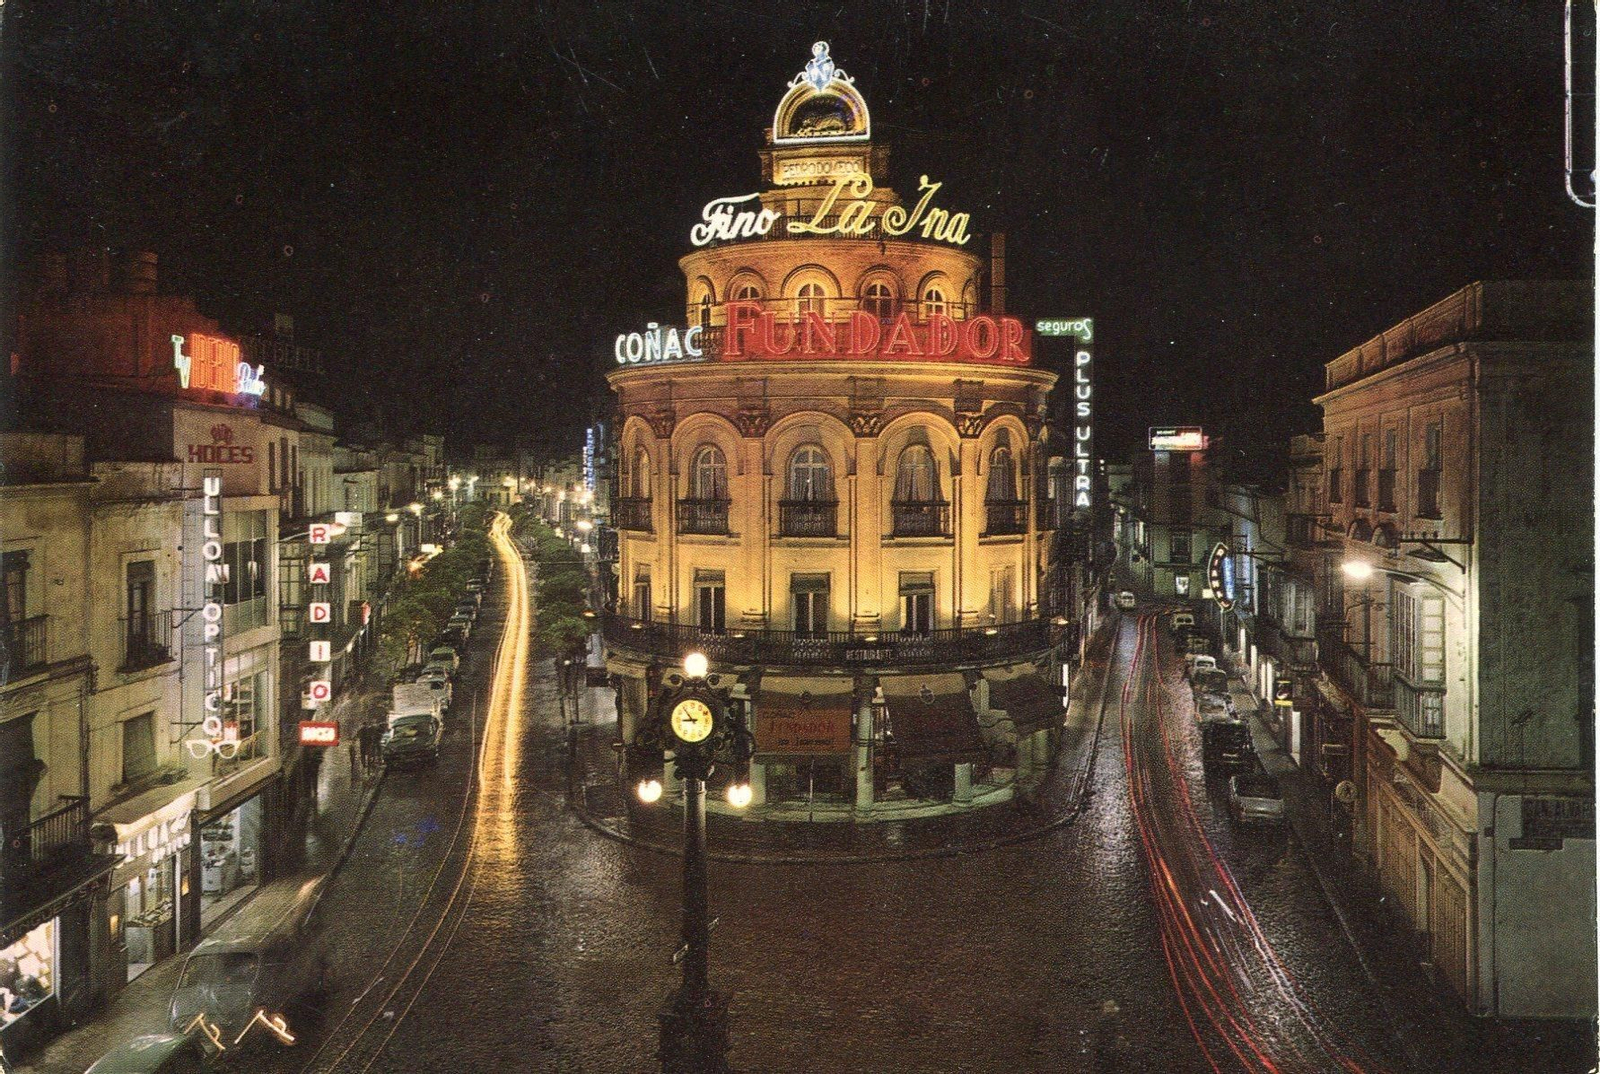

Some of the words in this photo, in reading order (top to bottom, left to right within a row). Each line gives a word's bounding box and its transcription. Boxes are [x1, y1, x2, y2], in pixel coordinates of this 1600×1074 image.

[690, 193, 781, 246] Fino
[787, 172, 876, 235] La
[615, 322, 703, 365] COÑAC
[722, 301, 1031, 363] FUNDADOR
[1075, 351, 1092, 417] PLUS
[188, 445, 253, 464] HOCES
[1075, 426, 1092, 507] ULTRA
[203, 477, 222, 584] ULLOA
[311, 525, 330, 700] RADIO
[203, 603, 222, 737] OPTICO
